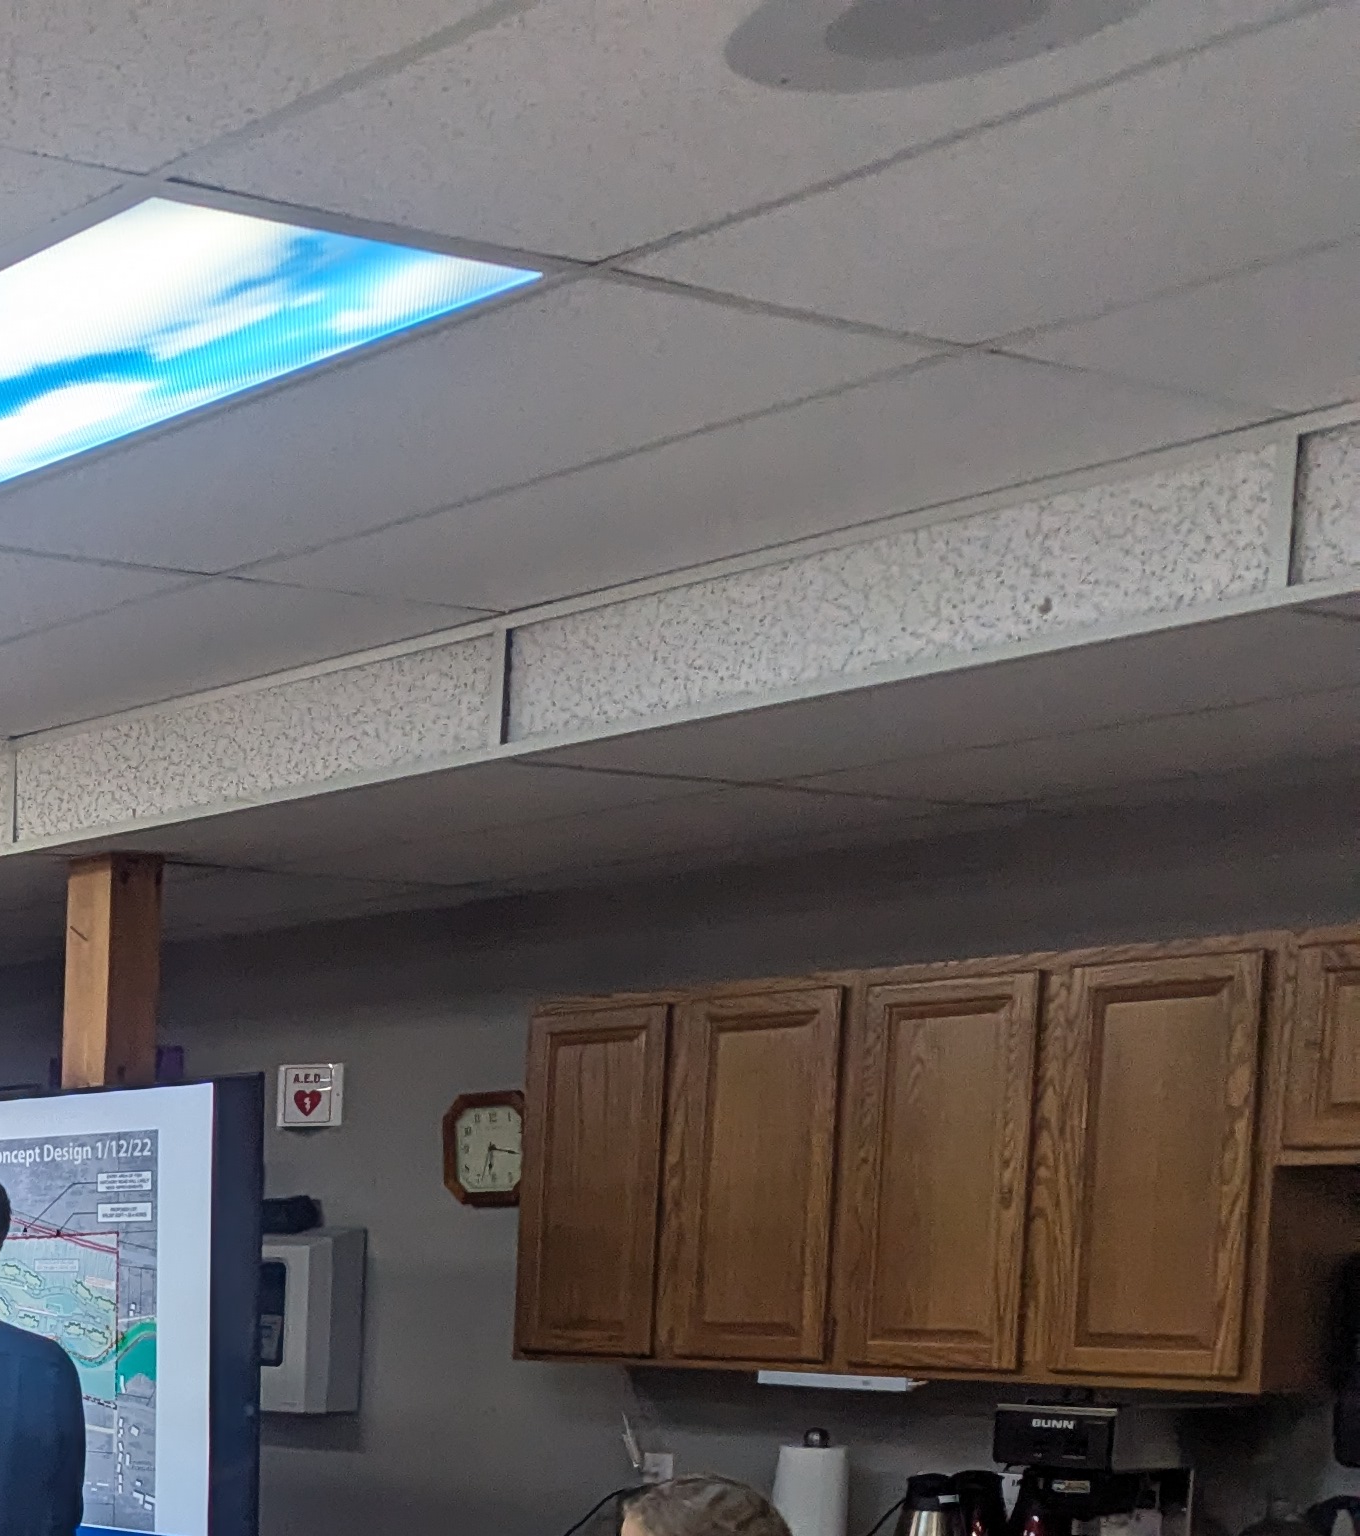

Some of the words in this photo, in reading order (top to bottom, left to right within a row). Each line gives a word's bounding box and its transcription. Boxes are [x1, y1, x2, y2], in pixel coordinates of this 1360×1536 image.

[43, 1141, 92, 1165] Design
[95, 1138, 152, 1160] 1/12/22
[1032, 1419, 1074, 1429] BUNN
